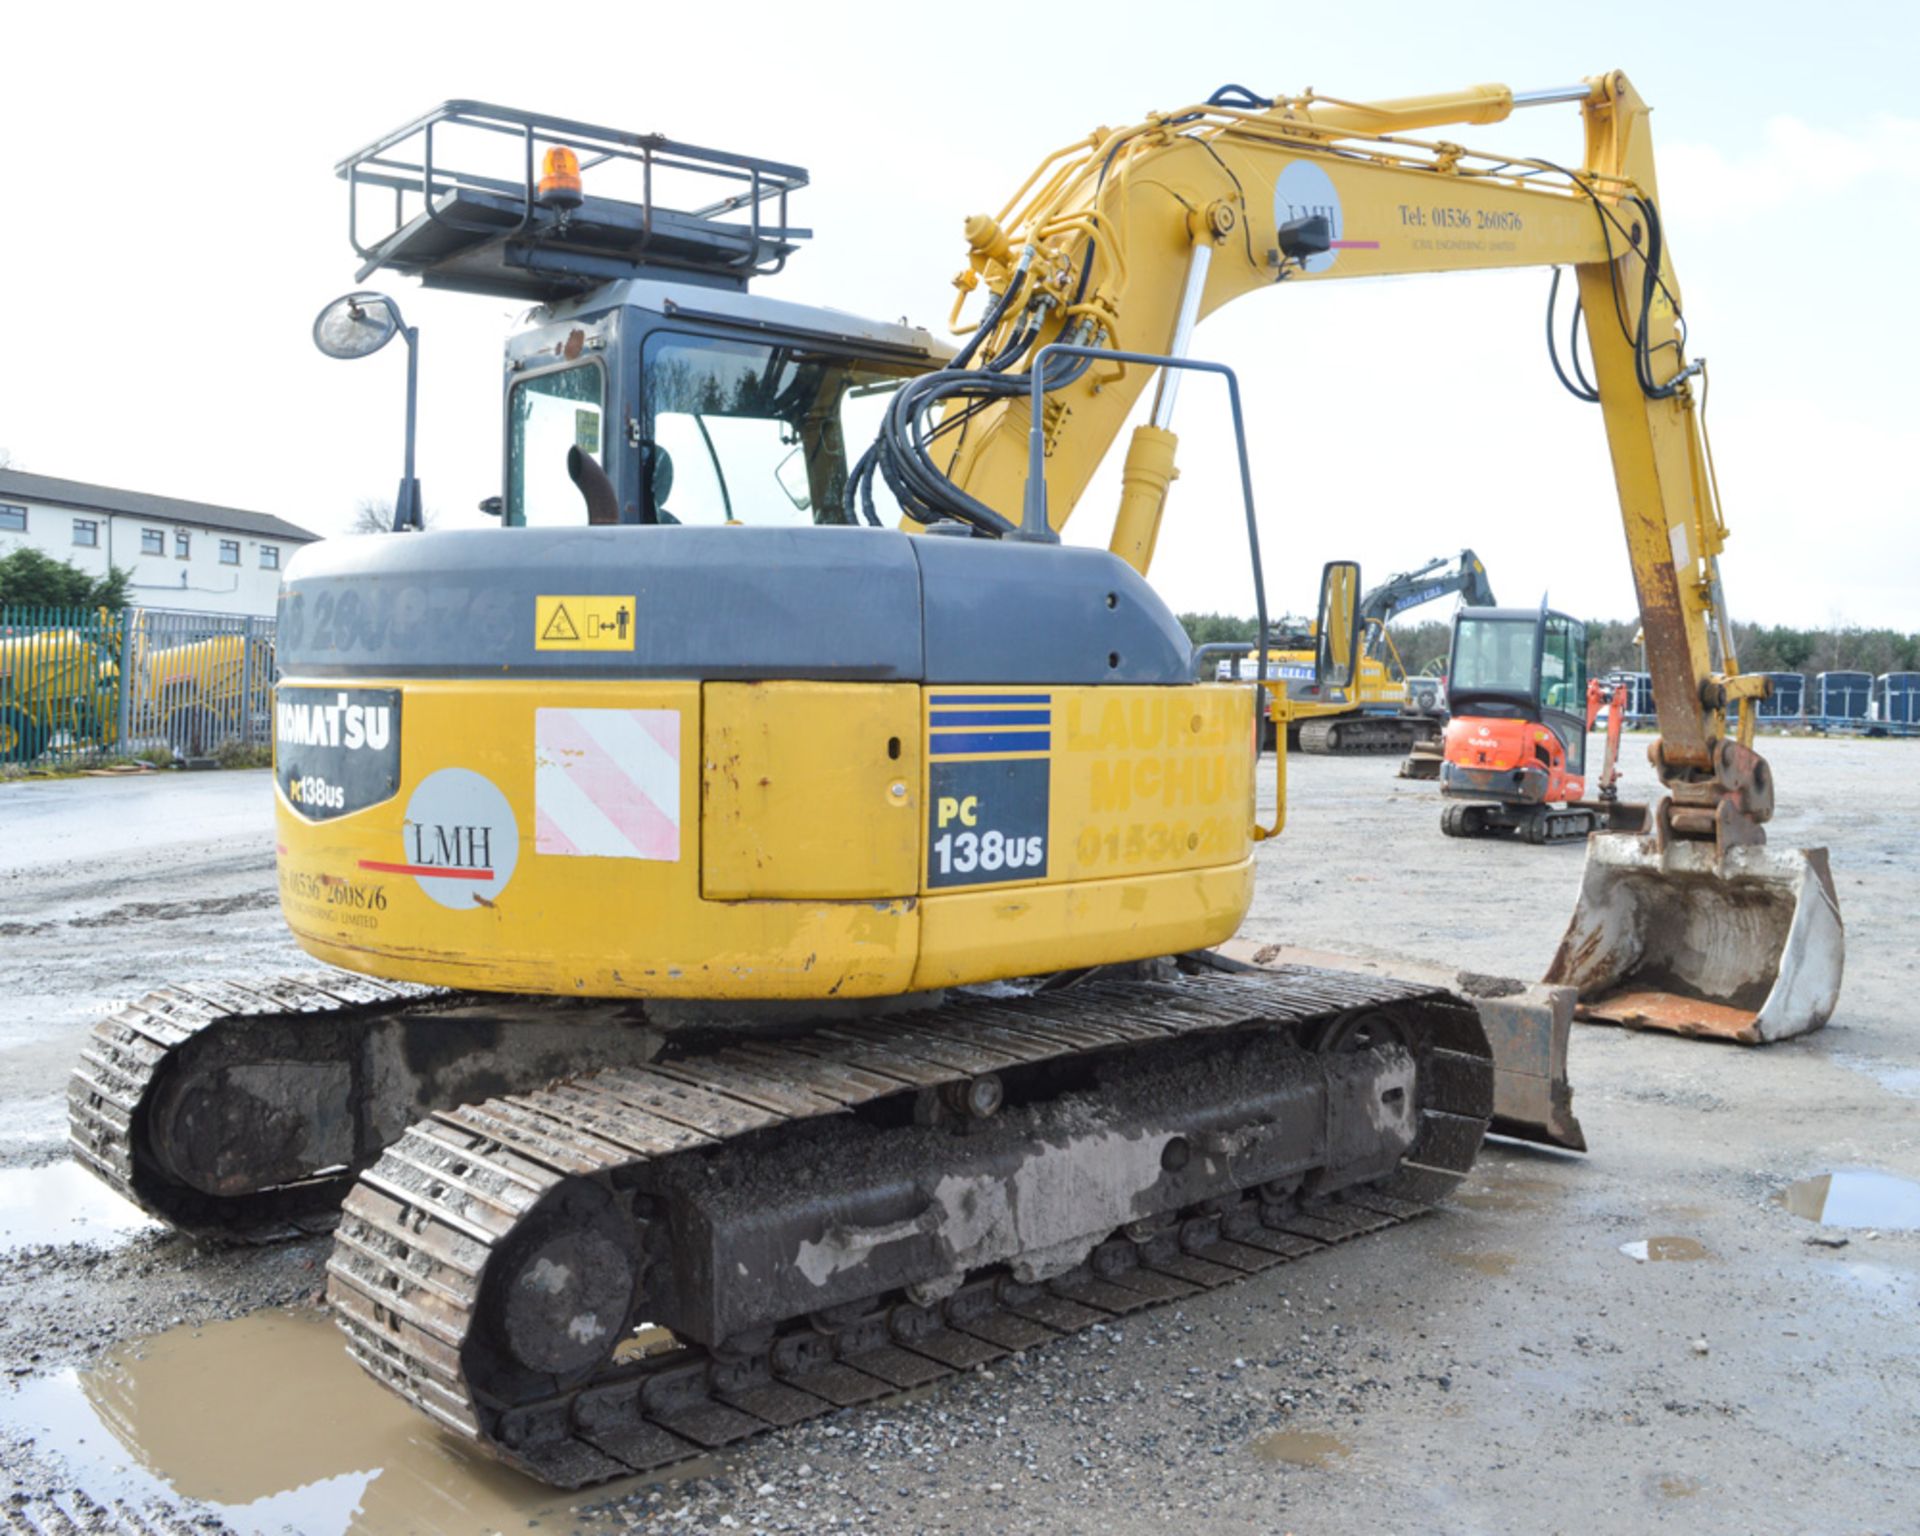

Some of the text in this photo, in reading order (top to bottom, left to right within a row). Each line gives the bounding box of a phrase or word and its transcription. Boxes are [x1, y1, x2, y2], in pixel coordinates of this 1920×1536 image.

[1398, 205, 1427, 227] Tel:
[1431, 207, 1471, 229] 01536
[1476, 209, 1523, 232] 260876
[277, 693, 390, 750] KOMATSU
[938, 796, 977, 828] PC
[414, 822, 493, 868] LMH
[327, 880, 388, 911] 260876
